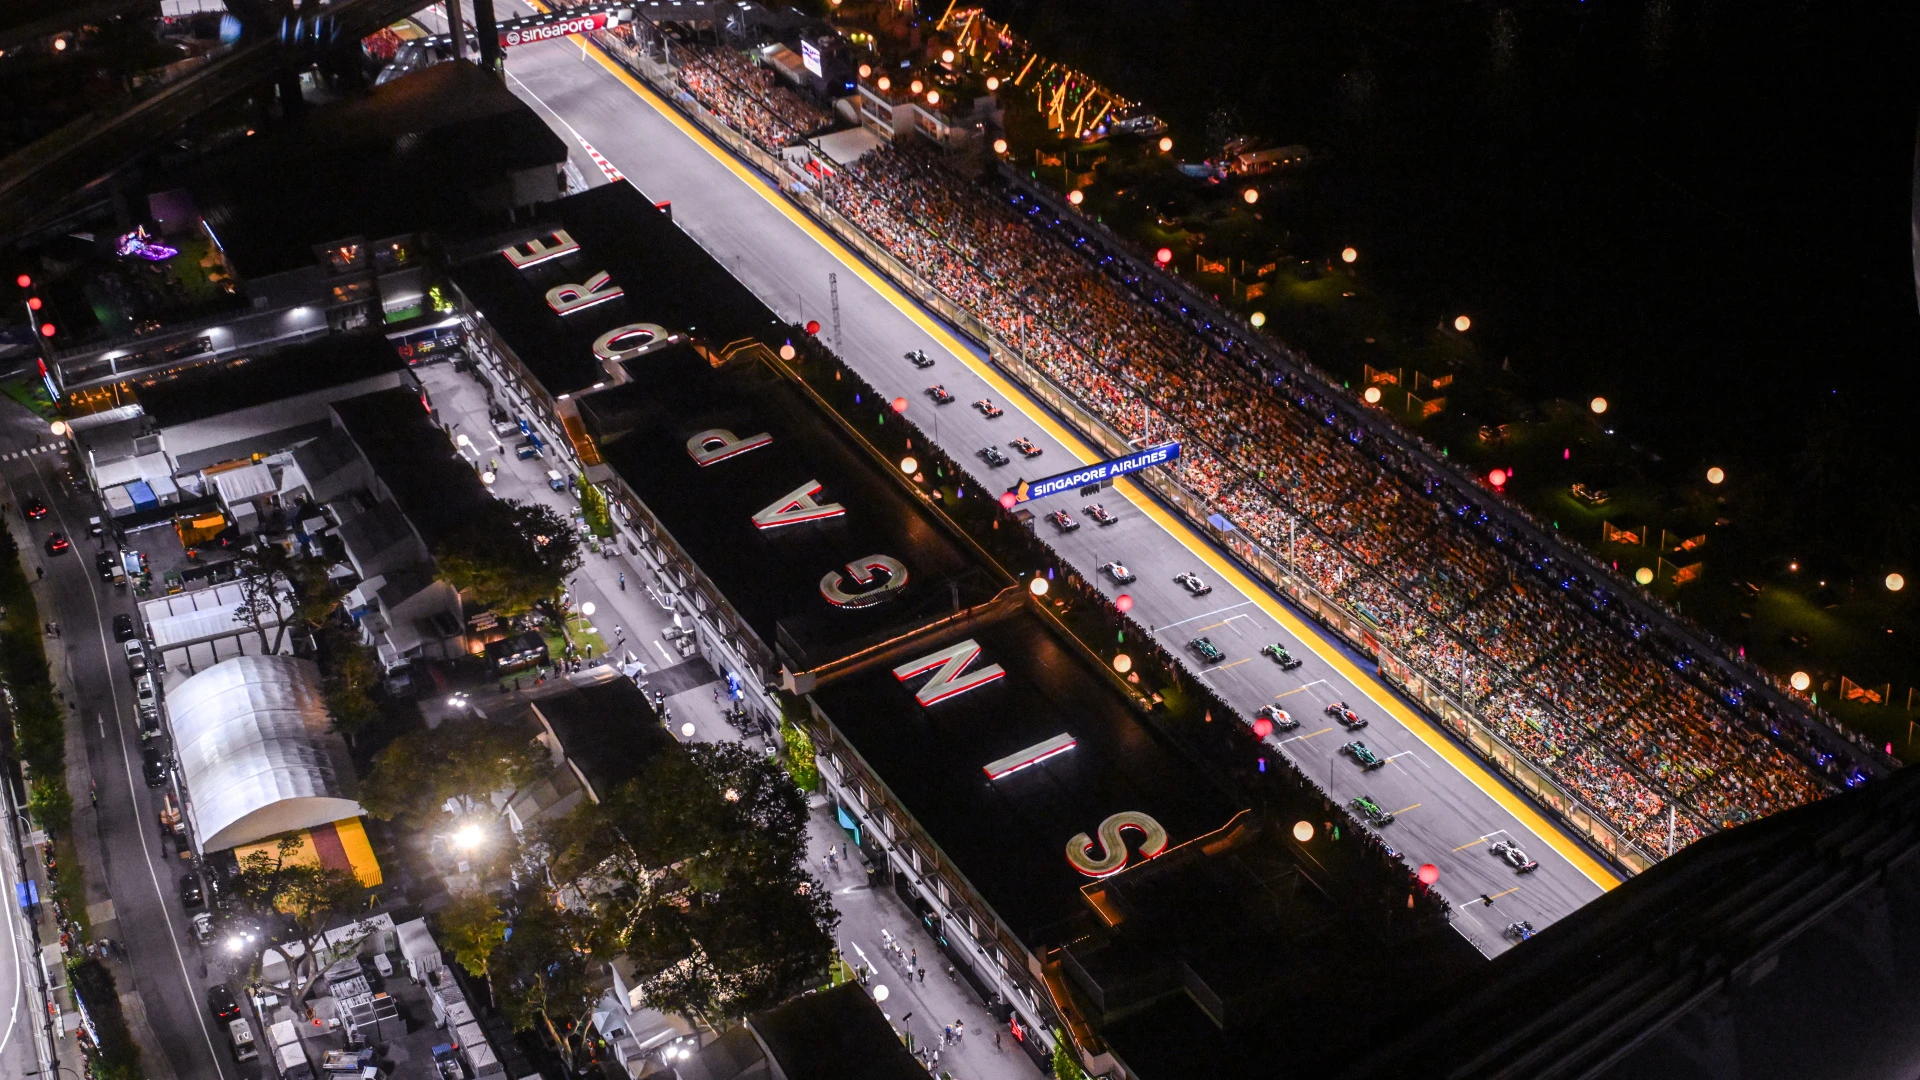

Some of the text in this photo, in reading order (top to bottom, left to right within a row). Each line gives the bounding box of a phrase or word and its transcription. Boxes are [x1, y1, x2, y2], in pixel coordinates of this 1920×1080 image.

[502, 229, 1168, 878] SINGAPORE
[1034, 450, 1167, 496] SINGAPORE AIRLINES
